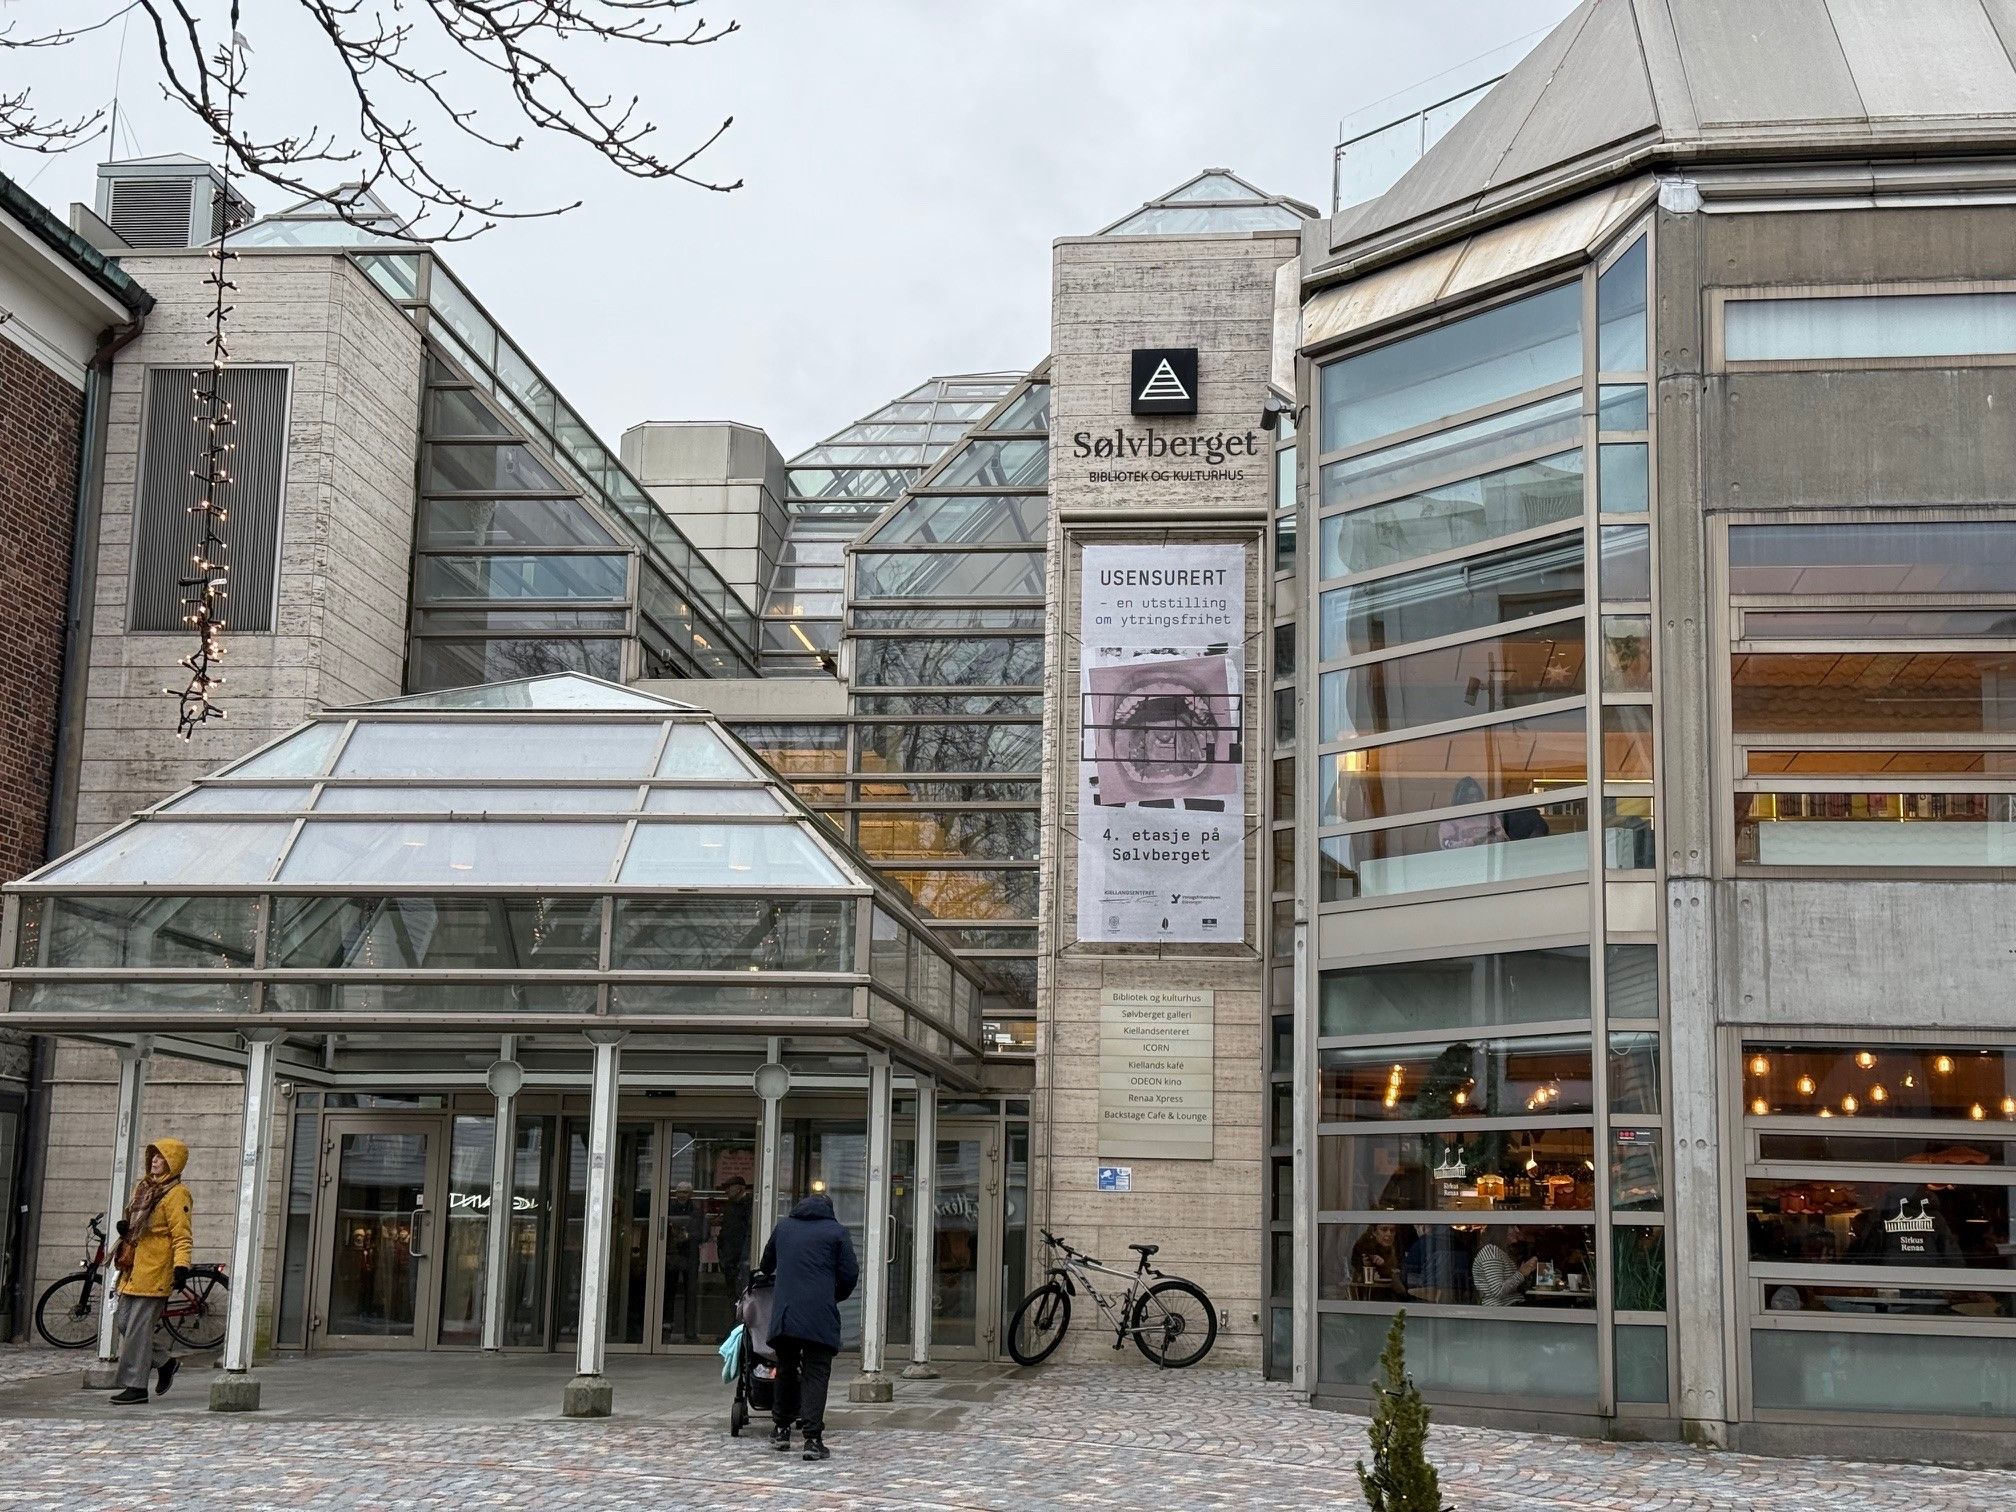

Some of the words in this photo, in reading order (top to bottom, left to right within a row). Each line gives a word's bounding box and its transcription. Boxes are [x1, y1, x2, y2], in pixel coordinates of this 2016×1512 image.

[1073, 429, 1258, 465] Sølvberget
[1089, 471, 1149, 483] BIBLIOTEK
[1151, 471, 1170, 483] OG
[1173, 470, 1244, 482] KULTURHUS
[1100, 569, 1227, 586] USENSURERT
[1116, 599, 1133, 609] en
[1142, 597, 1227, 611] utstilling
[1095, 616, 1112, 625] om
[1121, 613, 1231, 628] ytringsfrihet
[1102, 828, 1120, 842] 4.
[1132, 828, 1190, 845] etasje
[1201, 827, 1220, 844] på
[1112, 848, 1210, 864] Sølvberget
[1112, 993, 1148, 1002] Bibliotek
[1149, 995, 1160, 1004] og
[1162, 993, 1202, 1003] kulturhus
[1122, 1010, 1165, 1020] Sølvberget
[1166, 1011, 1192, 1020] galleri
[1123, 1027, 1190, 1036] Kiellandsenteret
[1143, 1044, 1170, 1052] ICORN
[1128, 1061, 1165, 1070] Kiellands
[1167, 1061, 1184, 1070] kafé
[1130, 1078, 1162, 1086] ODEON
[1164, 1078, 1182, 1086] kino
[1128, 1094, 1154, 1102] Renaa
[1155, 1095, 1183, 1104] Xpress
[1104, 1111, 1145, 1121] Backstage
[1147, 1111, 1166, 1120] Cafe
[1167, 1112, 1175, 1120] &
[1176, 1112, 1207, 1122] Lounge
